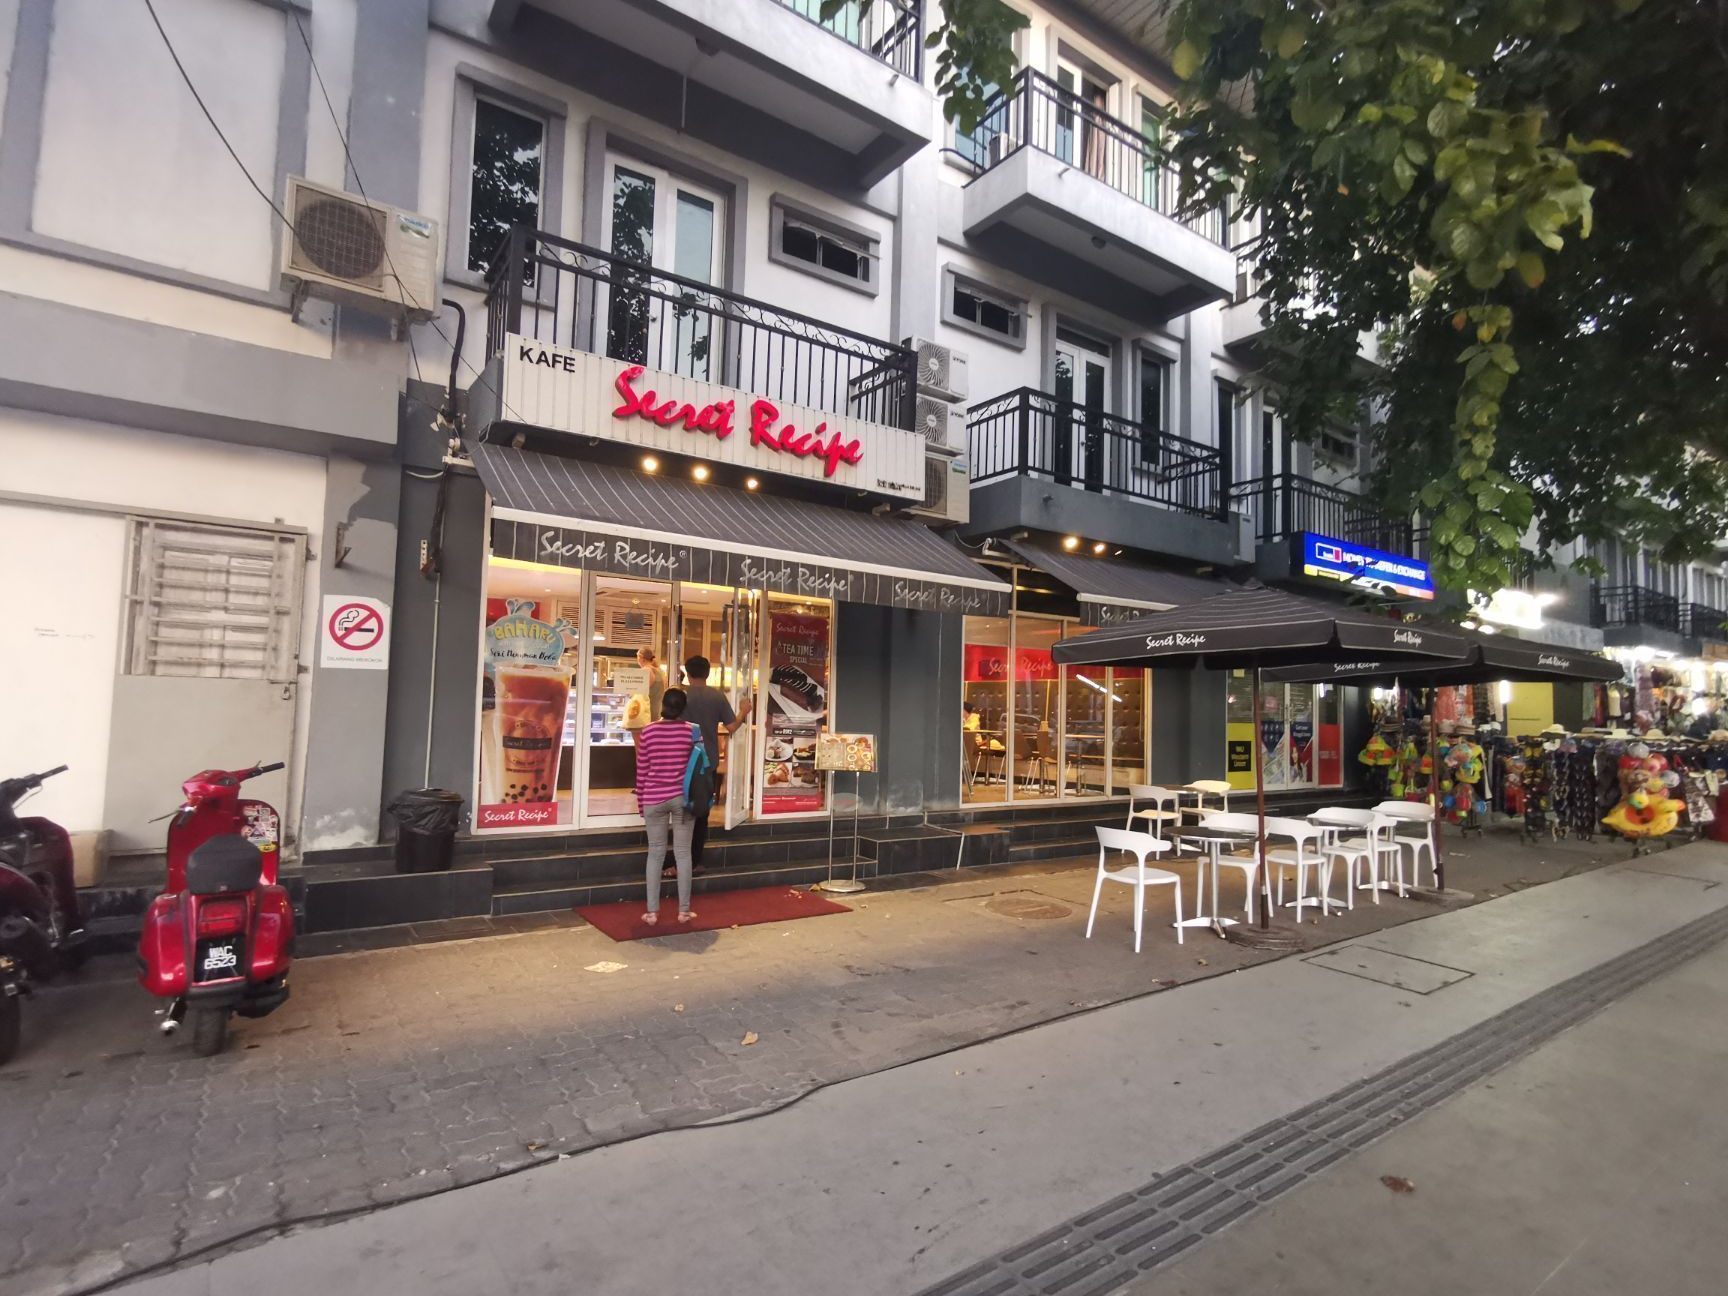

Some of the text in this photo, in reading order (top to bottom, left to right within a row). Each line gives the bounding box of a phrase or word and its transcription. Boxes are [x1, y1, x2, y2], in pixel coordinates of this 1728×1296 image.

[519, 345, 576, 373] KAFE
[612, 366, 864, 478] Secret Recipe
[539, 530, 679, 575] Secret Recipe
[739, 558, 848, 597] Secret Recipe
[782, 643, 814, 656] TEA TIME
[1146, 633, 1206, 650] Secret Recipe
[484, 809, 549, 823] Secret Recipe
